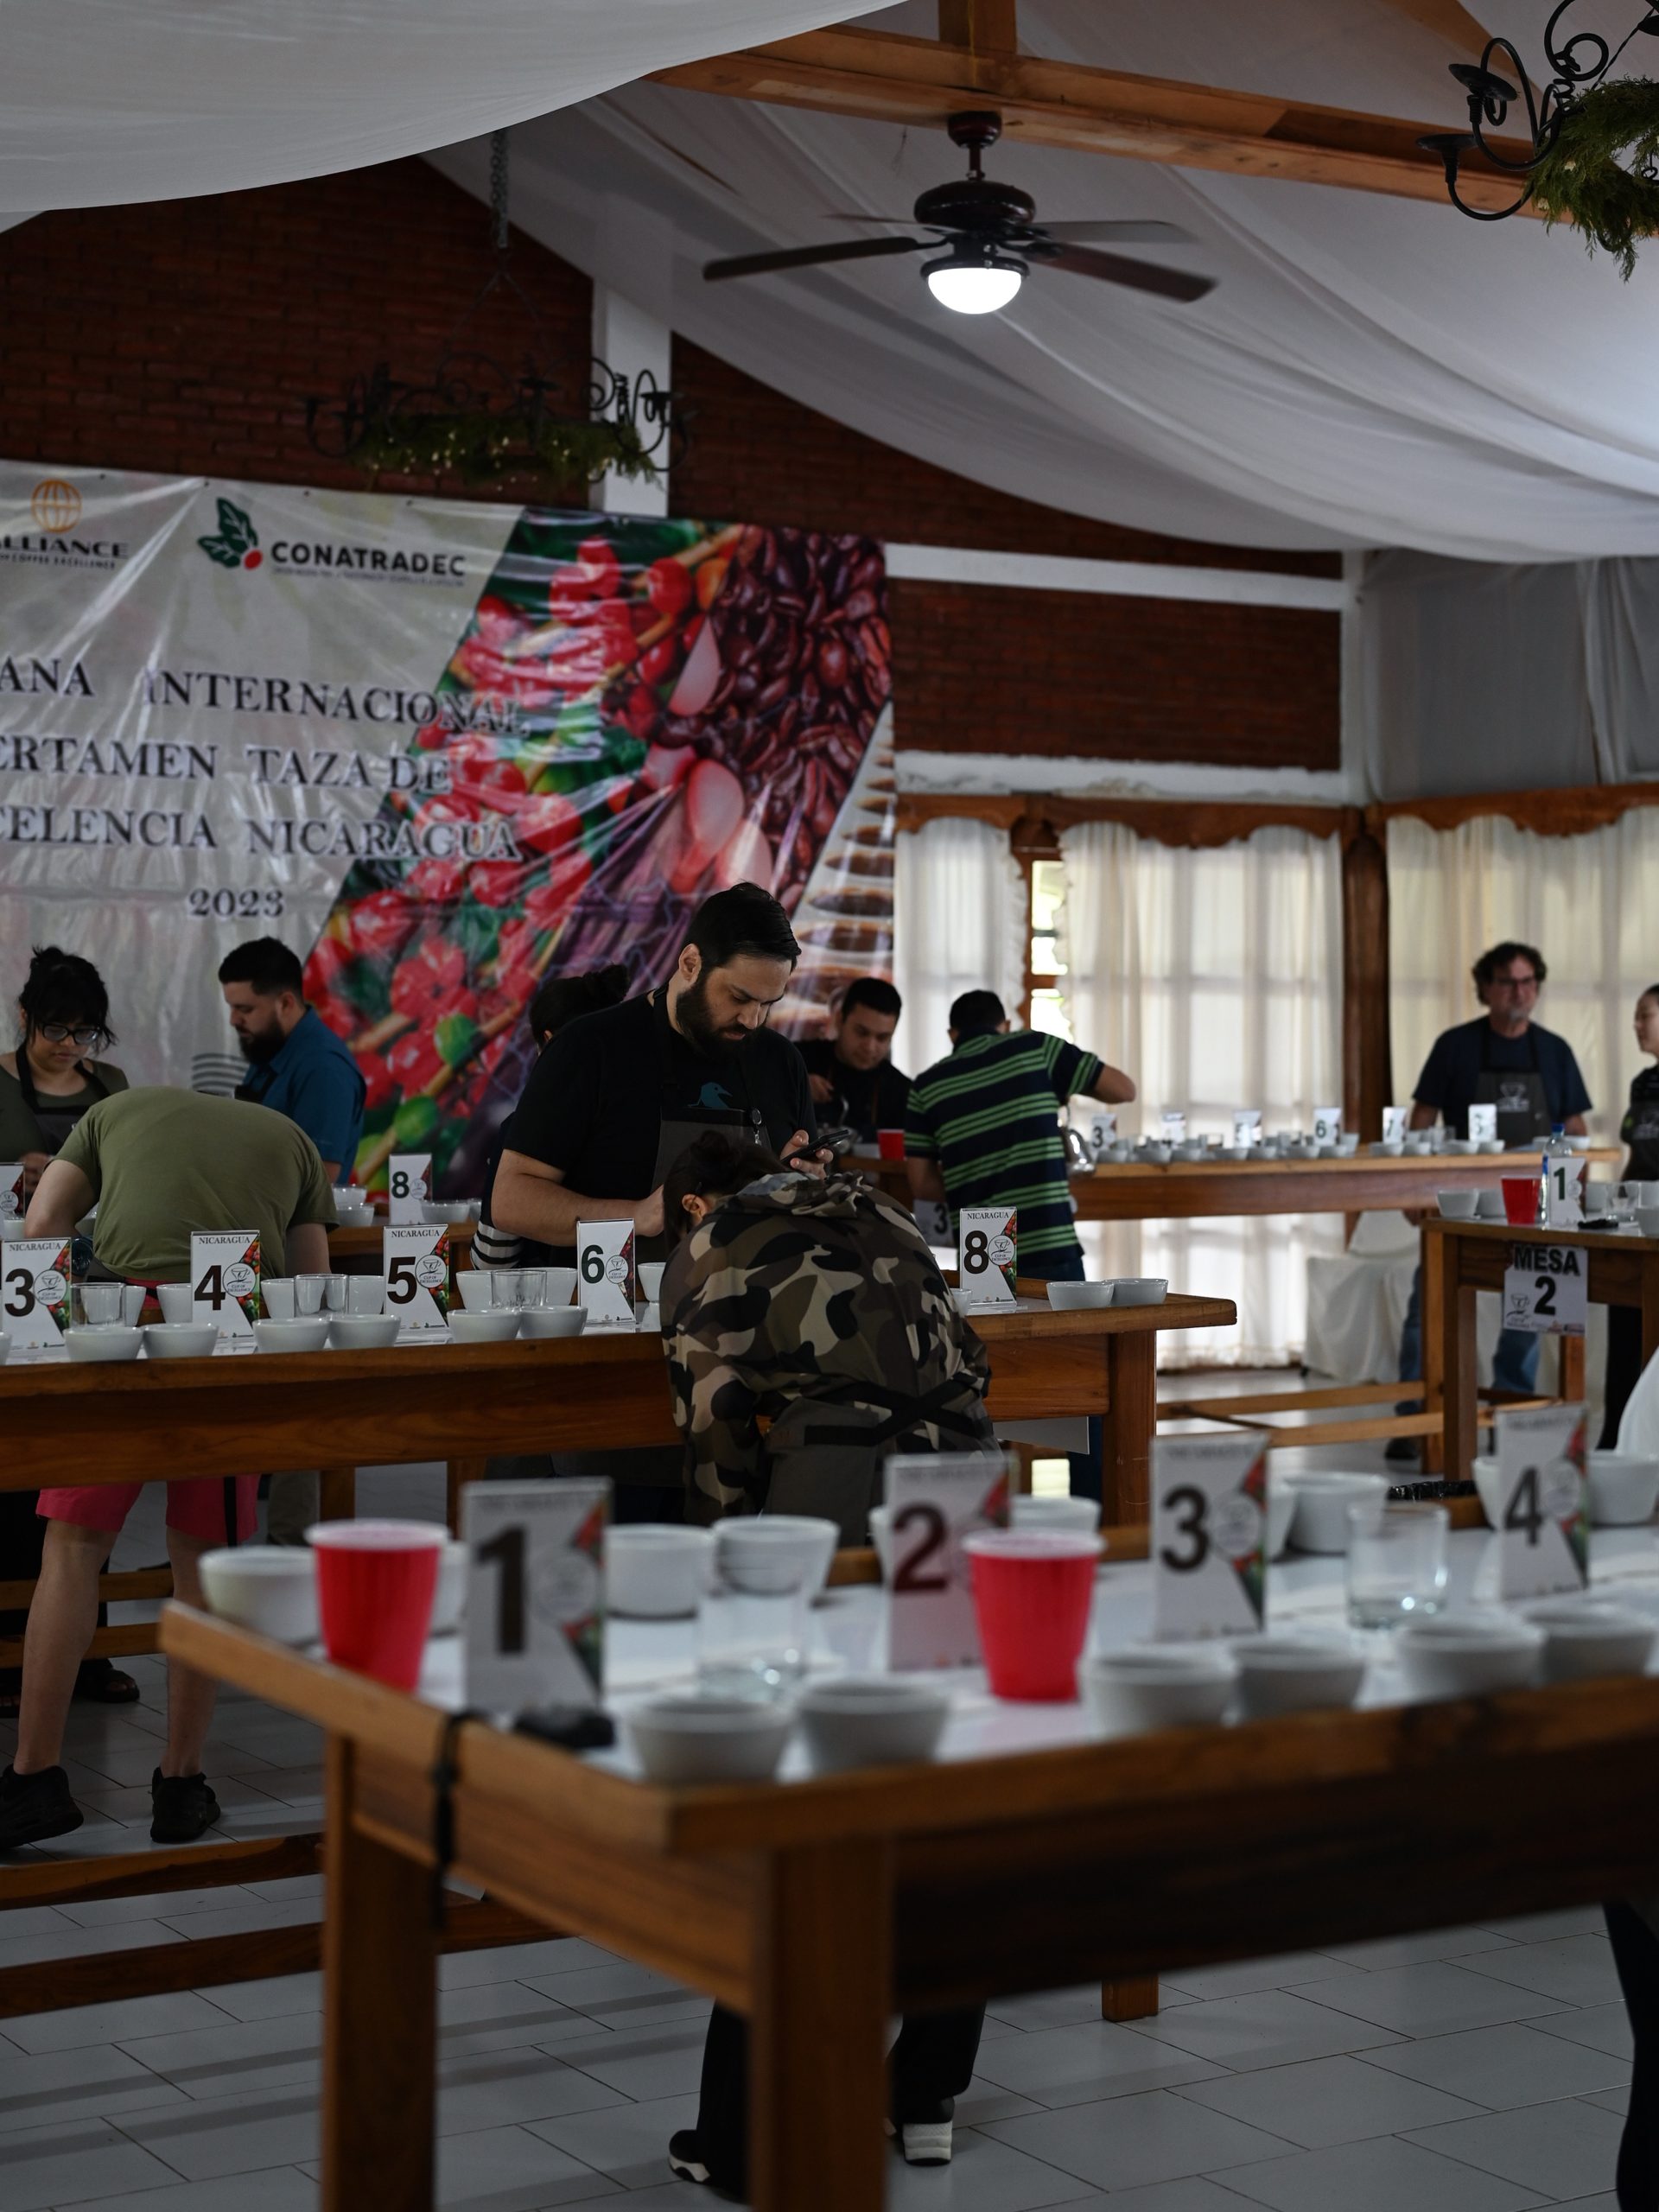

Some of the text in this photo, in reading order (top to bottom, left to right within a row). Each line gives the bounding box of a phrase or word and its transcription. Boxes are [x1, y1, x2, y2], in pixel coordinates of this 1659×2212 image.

[0, 535, 129, 559] LLIANCE
[271, 541, 466, 577] CONATRADEC
[247, 748, 372, 789] TAZA
[391, 755, 451, 793] DE
[0, 805, 519, 860] ELENCIA NICARAGUA
[189, 887, 284, 918] 2023
[1092, 1126, 1103, 1148] 3
[1315, 1120, 1326, 1139] 6
[391, 1171, 410, 1199] 8
[1553, 1167, 1566, 1200] 1
[934, 1204, 948, 1235] 3
[967, 1211, 1009, 1220] NICARAGUA
[10, 1243, 61, 1252] NICARAGUA
[199, 1236, 251, 1245] NICARAGUA
[391, 1230, 440, 1238] NICARAGUA
[963, 1230, 989, 1274] 8
[581, 1244, 605, 1284] 6
[1514, 1244, 1581, 1276] MESA
[4, 1268, 35, 1317] 3
[194, 1265, 226, 1311] 4
[387, 1256, 417, 1305] 5
[1534, 1275, 1557, 1316] 2
[1504, 1467, 1543, 1546] 4
[1161, 1484, 1211, 1572] 3
[892, 1501, 950, 1592] 2
[475, 1524, 527, 1656] 1
